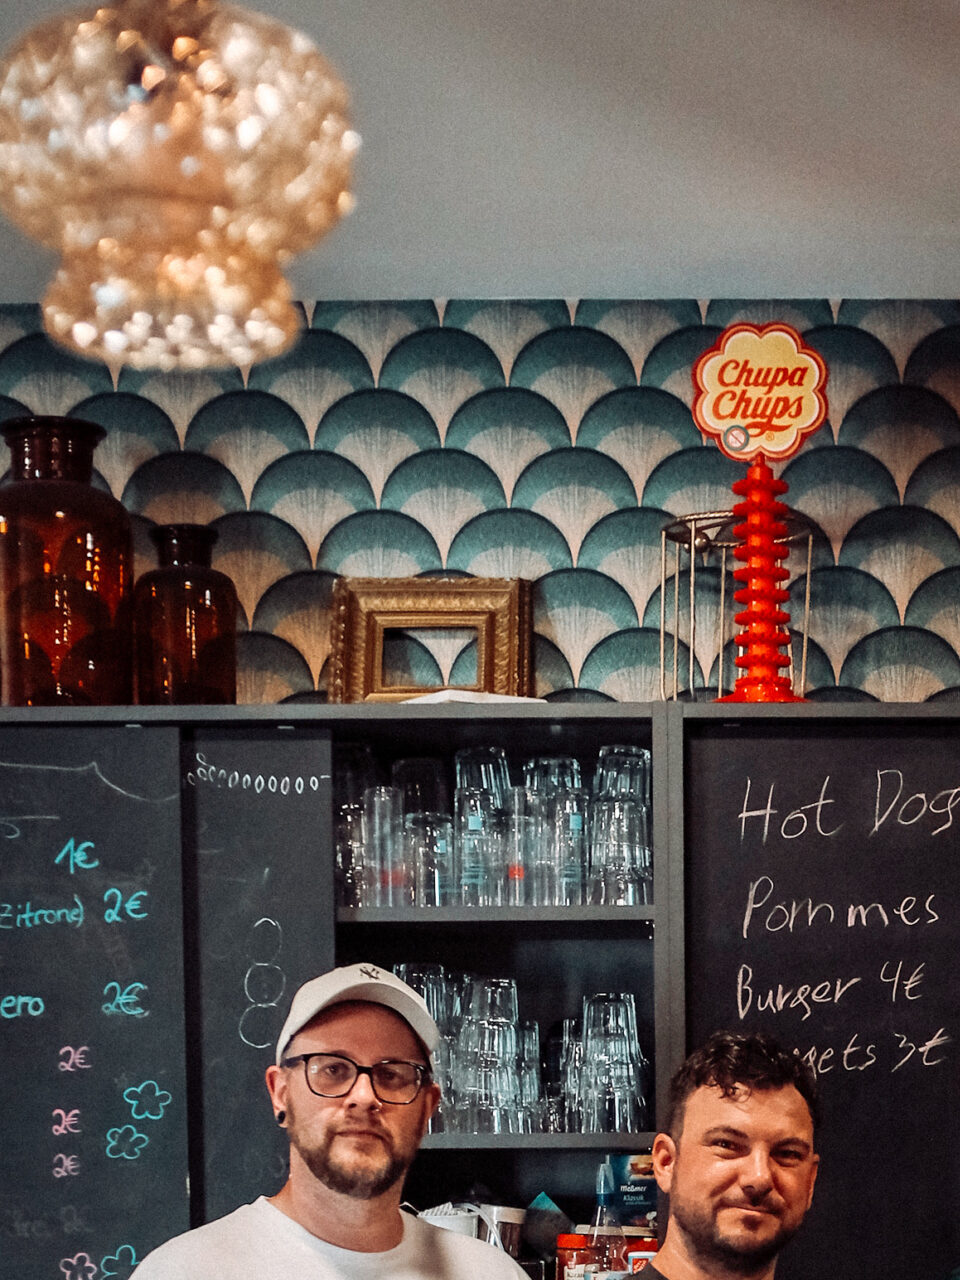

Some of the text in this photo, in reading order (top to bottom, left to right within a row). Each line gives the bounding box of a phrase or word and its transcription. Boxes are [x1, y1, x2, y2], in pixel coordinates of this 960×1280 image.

[717, 359, 809, 395] Chupa
[712, 389, 803, 438] Chups
[738, 776, 842, 845] Hot
[54, 836, 100, 875] 1€
[103, 887, 149, 924] 2€
[742, 876, 940, 938] Pommes
[101, 981, 150, 1018] 2€
[736, 961, 926, 1020] Burger 4€
[58, 1045, 92, 1072] 2€
[891, 1027, 950, 1073] 3€
[51, 1108, 82, 1136] 2€
[52, 1152, 80, 1178] 2€
